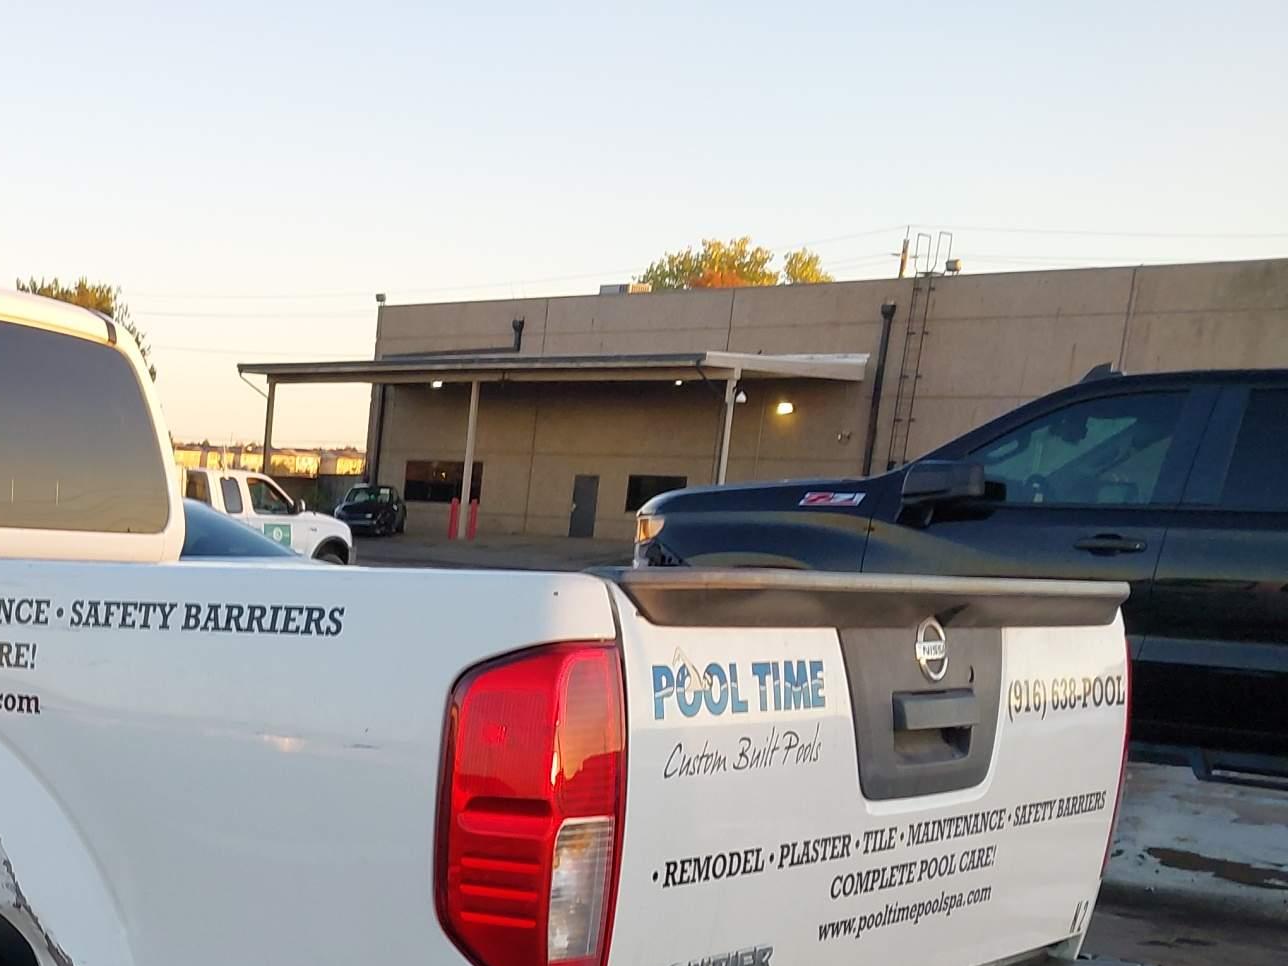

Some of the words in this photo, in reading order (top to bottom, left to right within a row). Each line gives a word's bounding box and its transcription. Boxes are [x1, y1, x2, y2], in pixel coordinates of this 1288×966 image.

[70, 600, 179, 630] SAFETY
[181, 603, 346, 637] BARRIERS
[652, 661, 749, 721] POOL
[751, 660, 826, 712] TIME
[1008, 678, 1047, 723] (916)
[1051, 676, 1125, 711] 638-POOL
[663, 739, 728, 779] Custom
[732, 726, 780, 771] Built
[782, 722, 822, 766] Pools
[662, 848, 765, 889] REMODEL
[777, 834, 852, 870] PLASTER
[862, 827, 898, 855] TILE
[906, 808, 1006, 847] MAINTENANCE
[1012, 798, 1058, 827] SAFETY
[1056, 790, 1108, 819] BARRIERS
[830, 861, 917, 900] COMPLETE
[917, 854, 957, 882] POOL
[958, 844, 998, 873] CARE!
[818, 885, 992, 942] www.pooltimepoolspa.com
